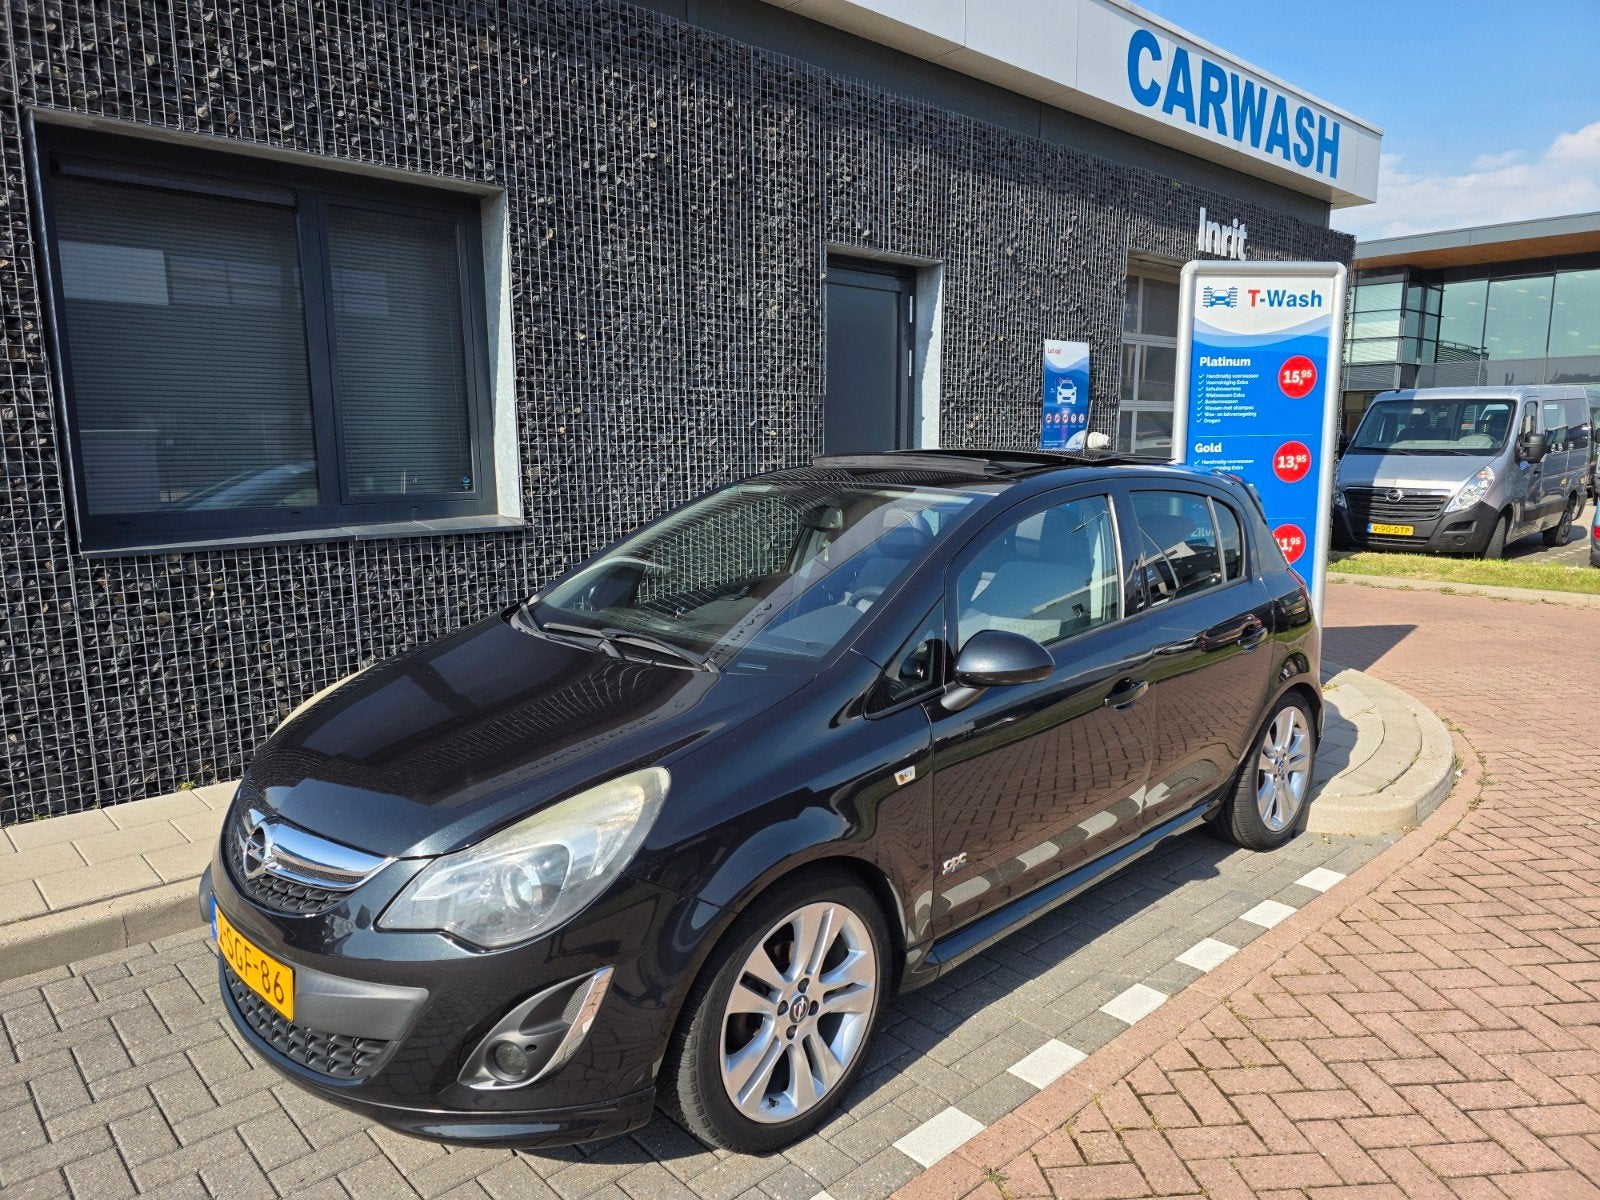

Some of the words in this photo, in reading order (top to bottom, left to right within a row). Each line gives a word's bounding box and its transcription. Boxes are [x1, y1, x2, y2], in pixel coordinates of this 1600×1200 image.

[1127, 29, 1340, 179] CARWASH
[1199, 206, 1248, 261] Inrit
[1248, 289, 1322, 308] T-Wash
[1199, 356, 1251, 367] Platinum
[1283, 370, 1312, 385] 15,95
[1194, 442, 1222, 453] Gold
[1277, 455, 1307, 470] 13,95
[1373, 525, 1411, 534] V-90-DTP
